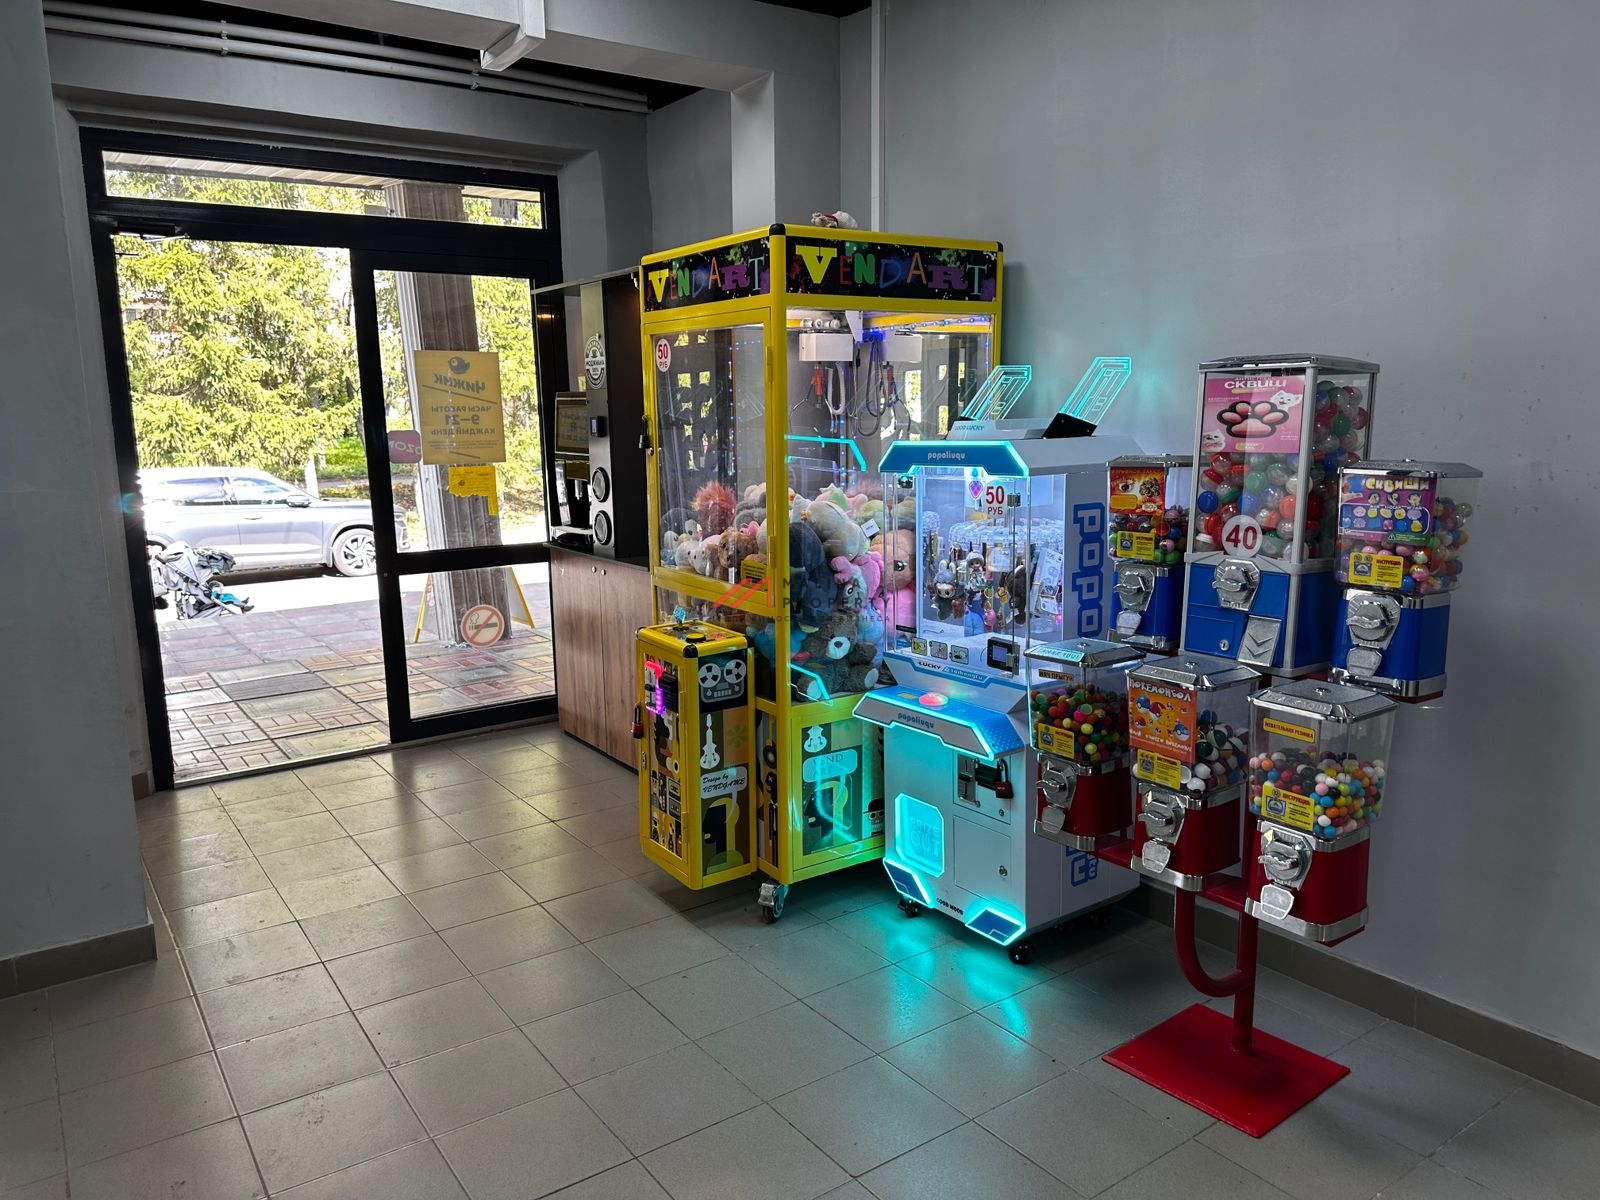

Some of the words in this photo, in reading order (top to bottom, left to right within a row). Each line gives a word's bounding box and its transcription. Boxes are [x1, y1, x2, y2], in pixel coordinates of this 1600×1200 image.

[657, 343, 669, 360] 50
[659, 361, 668, 369] РУБ
[985, 485, 1005, 505] 50
[987, 506, 1004, 516] РУБ
[1225, 524, 1258, 550] 40
[919, 661, 941, 670] LUCKY
[702, 775, 721, 784] Design
[702, 777, 746, 793] VENDGAME
[910, 816, 939, 837] PRIZE
[911, 829, 941, 857] OUT
